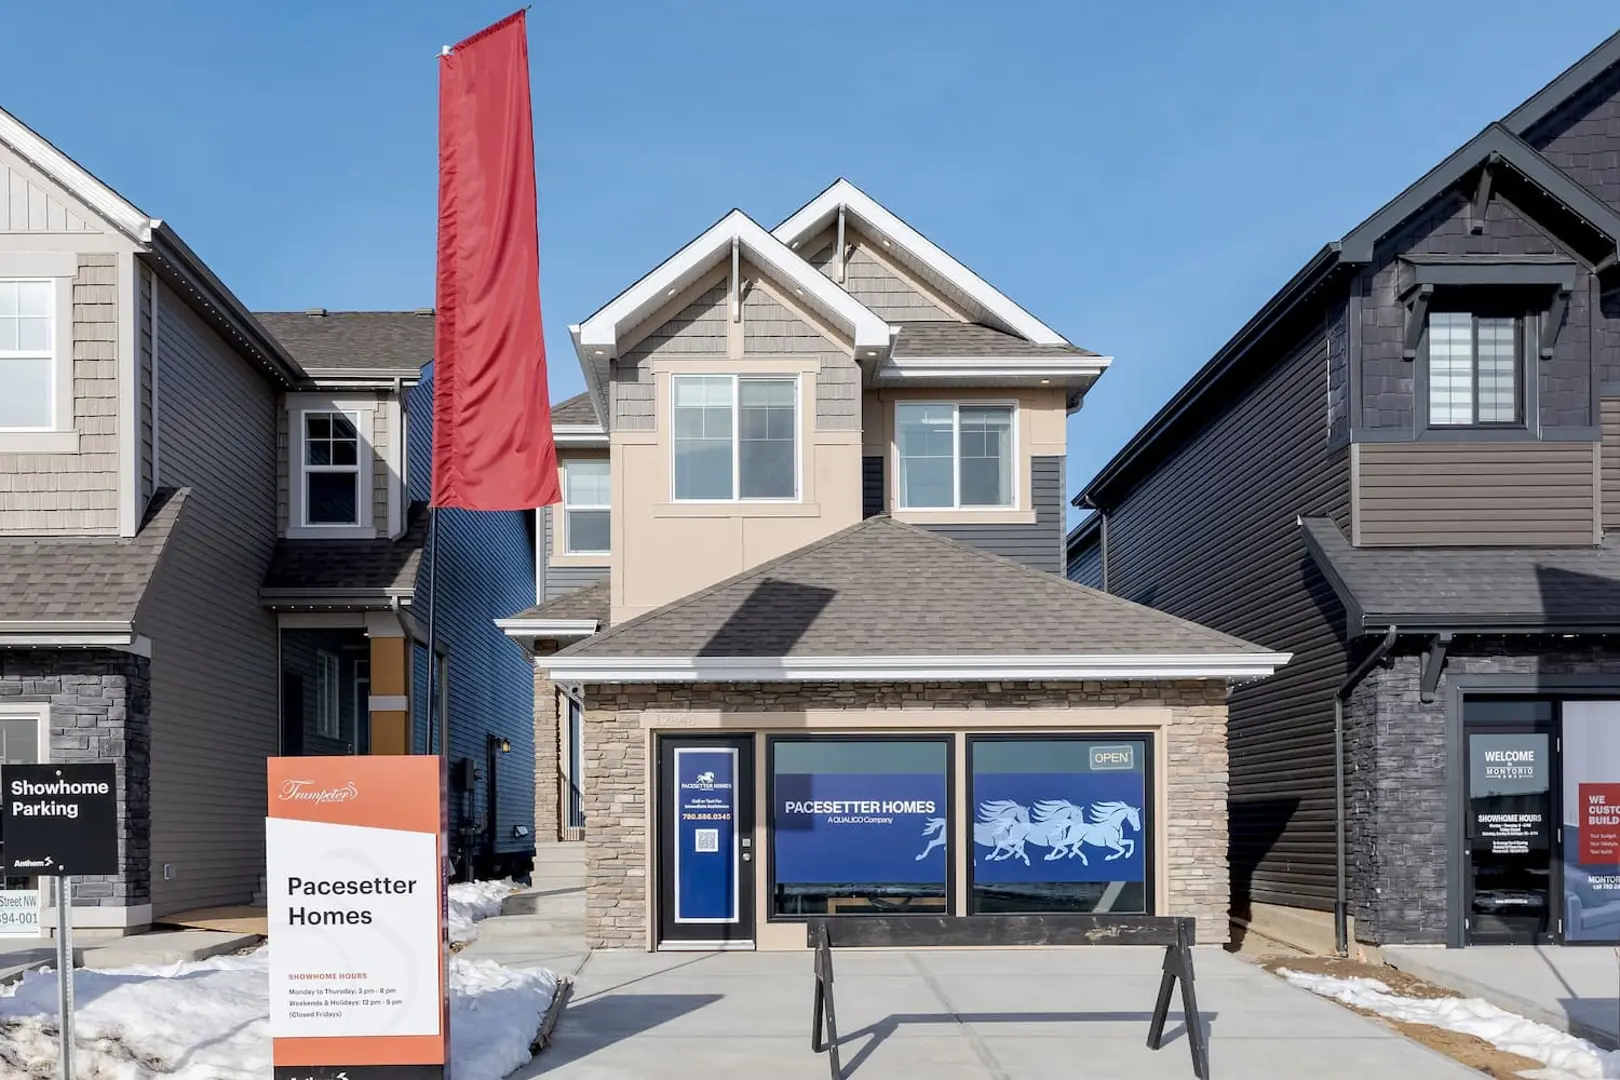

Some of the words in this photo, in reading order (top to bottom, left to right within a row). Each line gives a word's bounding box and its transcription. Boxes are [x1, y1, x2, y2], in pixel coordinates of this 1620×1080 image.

[1095, 752, 1128, 763] OPEN
[1485, 751, 1534, 761] WELCOME
[11, 780, 109, 795] Showhome
[278, 780, 358, 804] Trumpeter
[1589, 795, 1606, 804] WE
[13, 800, 79, 819] Parking
[785, 800, 880, 814] PACESETTER
[882, 800, 936, 814] HOMES
[827, 816, 833, 824] A
[833, 816, 864, 824] QUALICO
[864, 816, 894, 824] Company
[1478, 814, 1518, 822] SHOWHOME
[1519, 814, 1542, 822] HOURS
[1589, 816, 1620, 825] BUILD
[14, 859, 45, 867] Anthem
[288, 877, 417, 896] Pacesetter
[24, 895, 36, 907] NW
[0, 912, 38, 924] 94-001
[289, 906, 373, 925] Homes
[288, 988, 315, 996] Monday
[330, 999, 359, 1007] Holidays:
[288, 1011, 315, 1019] (Closed
[315, 1010, 342, 1018] Fridays)
